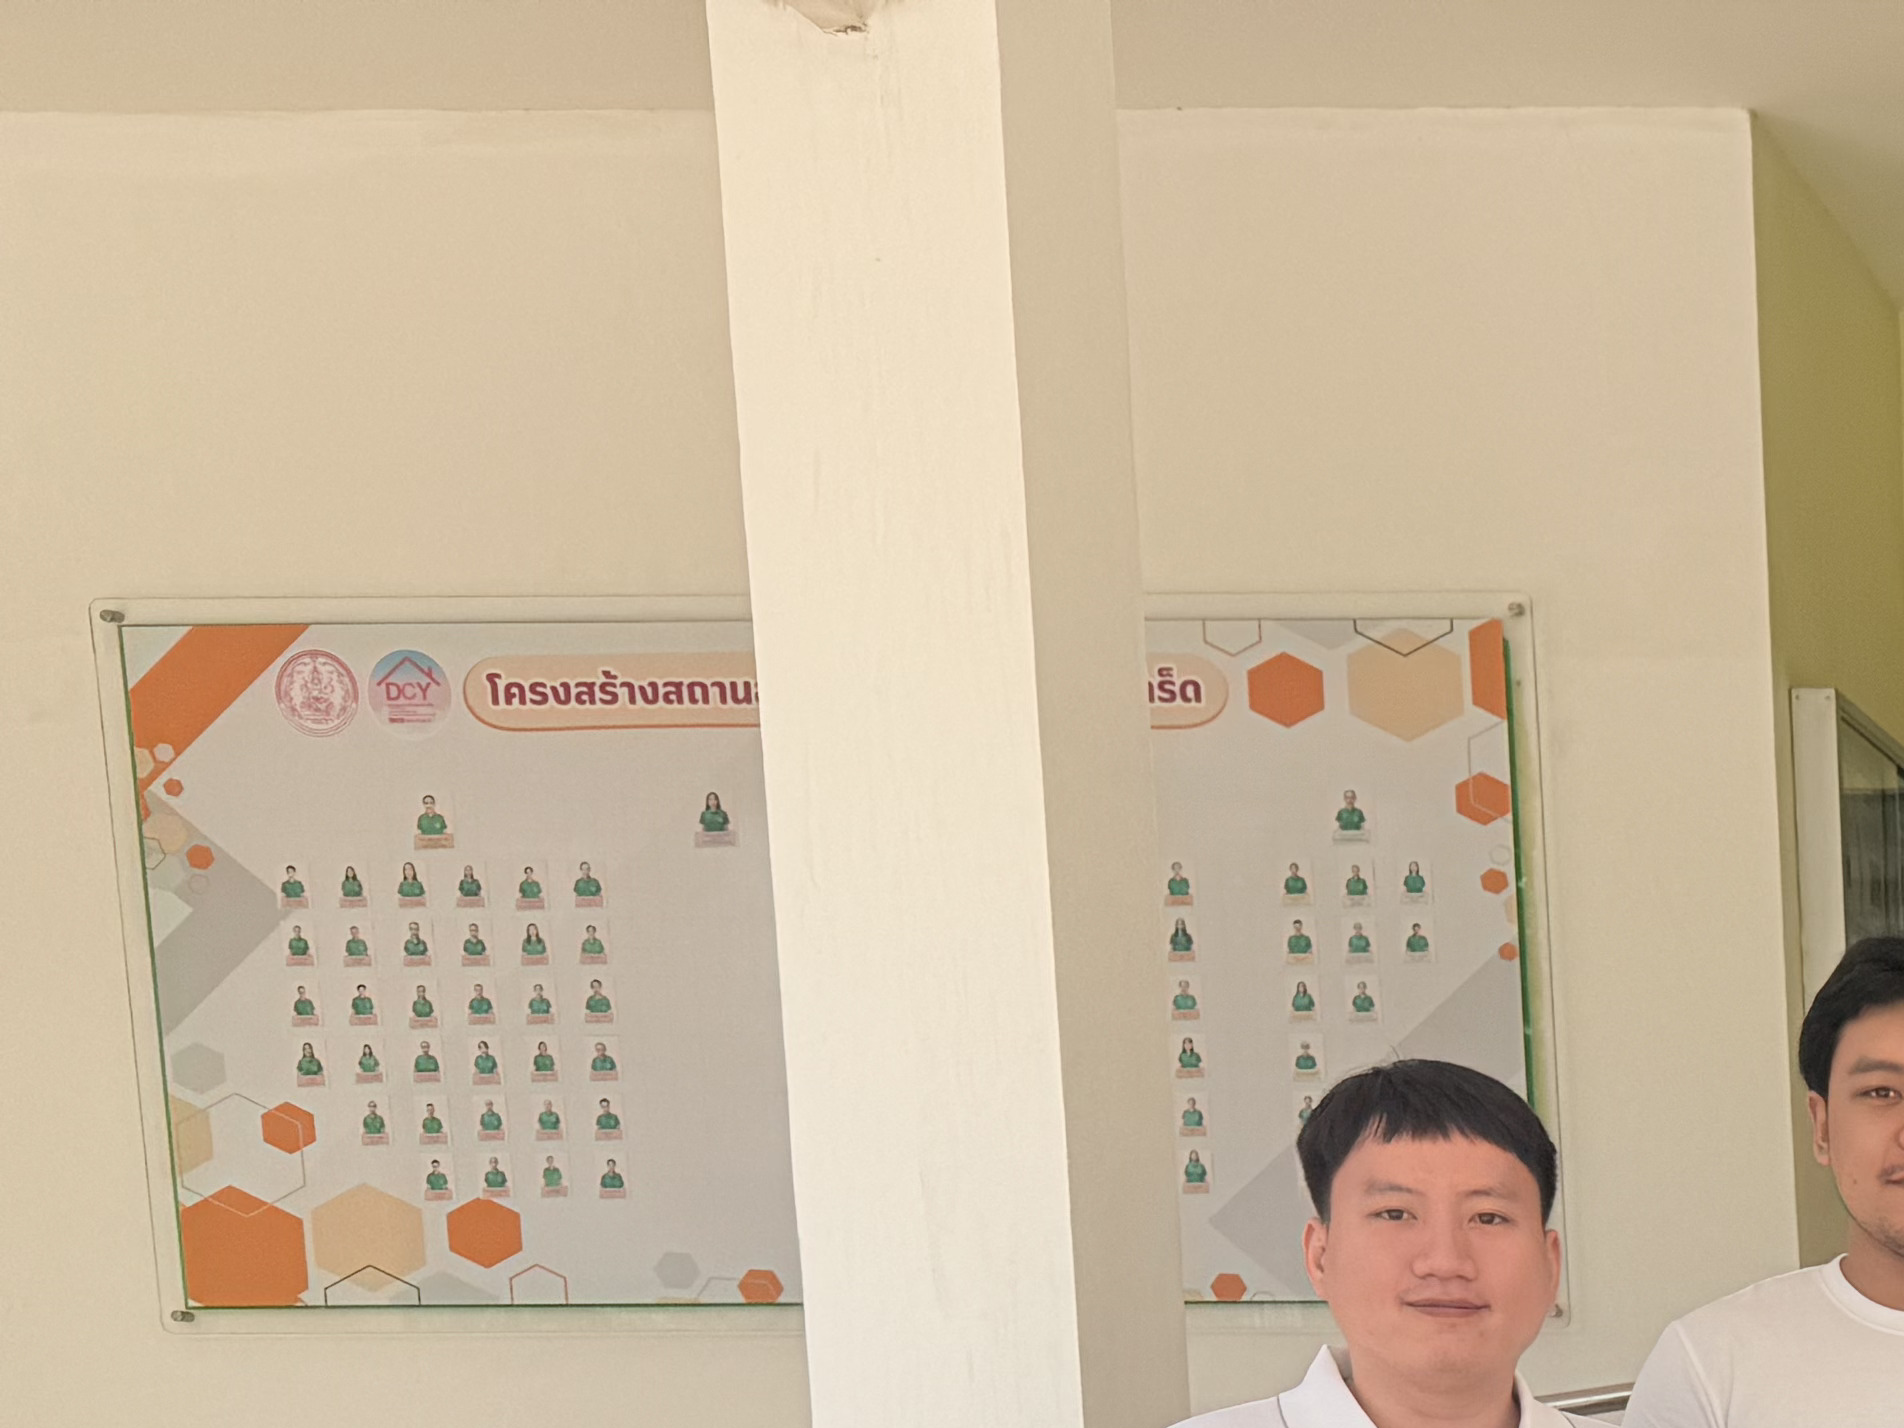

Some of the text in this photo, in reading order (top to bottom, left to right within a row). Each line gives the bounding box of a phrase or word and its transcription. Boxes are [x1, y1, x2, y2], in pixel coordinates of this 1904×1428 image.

[386, 682, 430, 701] DCY
[486, 671, 762, 707] โครงสร้างสถาน
